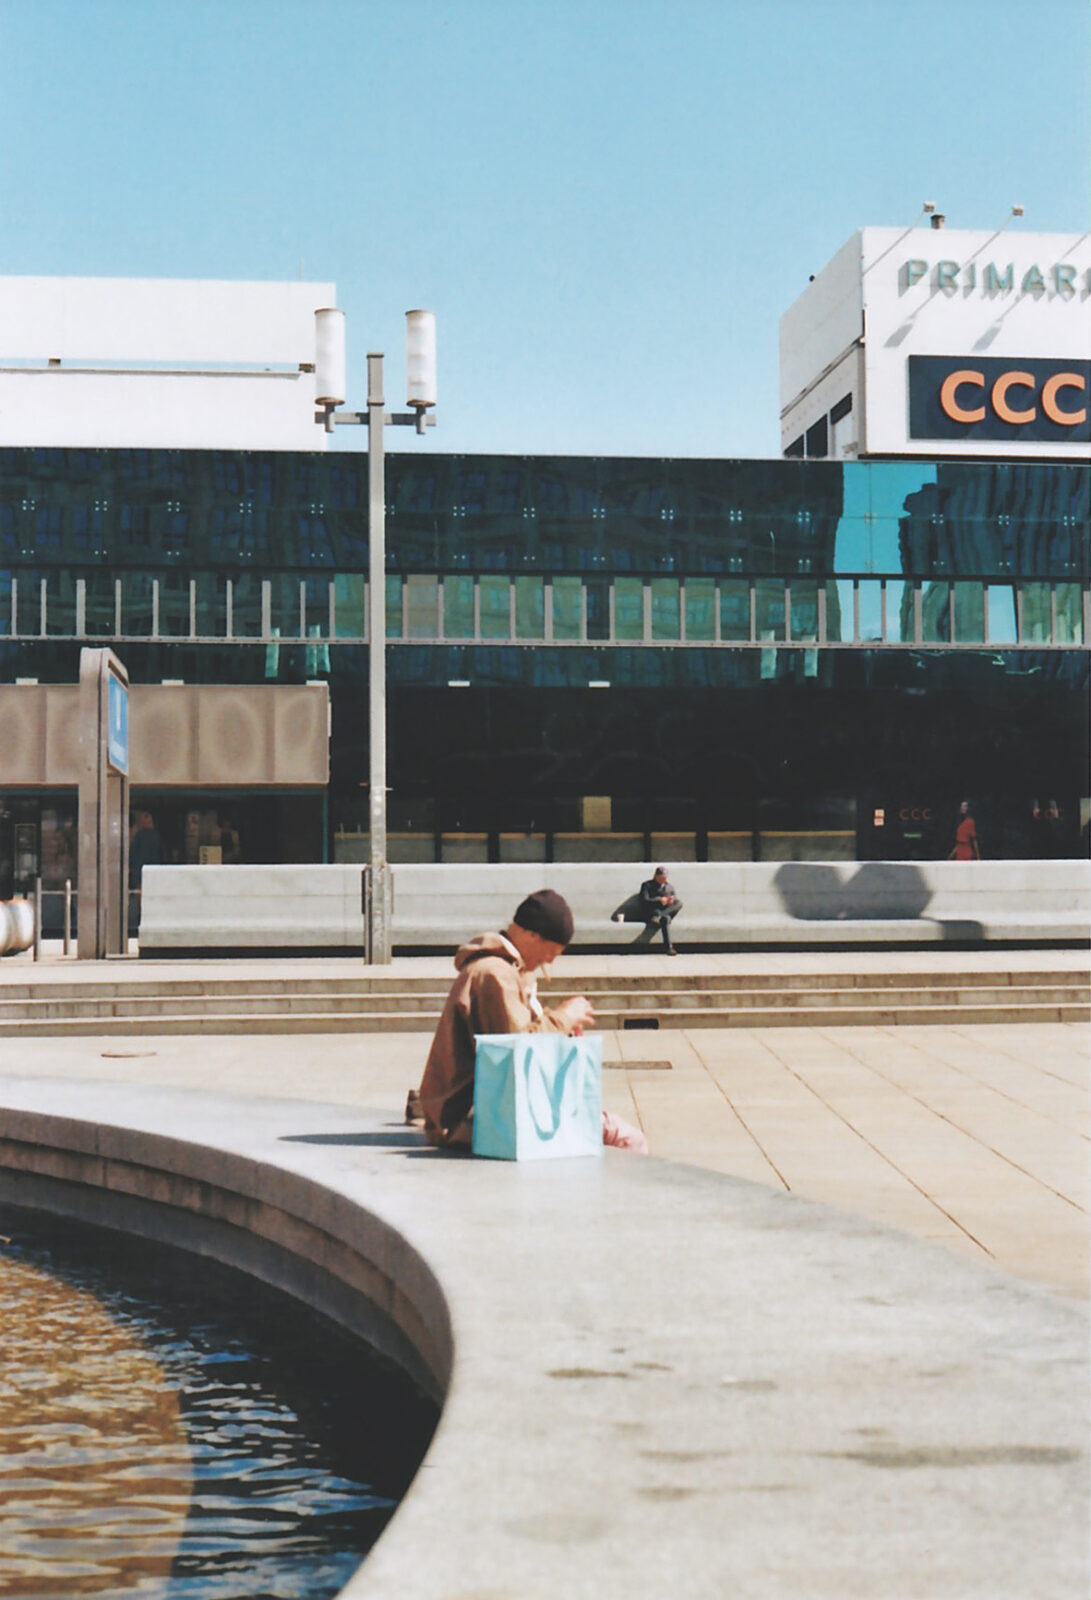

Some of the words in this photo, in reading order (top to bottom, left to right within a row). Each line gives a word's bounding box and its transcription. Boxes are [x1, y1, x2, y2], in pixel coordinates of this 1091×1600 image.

[907, 259, 1091, 295] PRIMAR
[940, 370, 1086, 425] CCC
[900, 808, 932, 820] CCC
